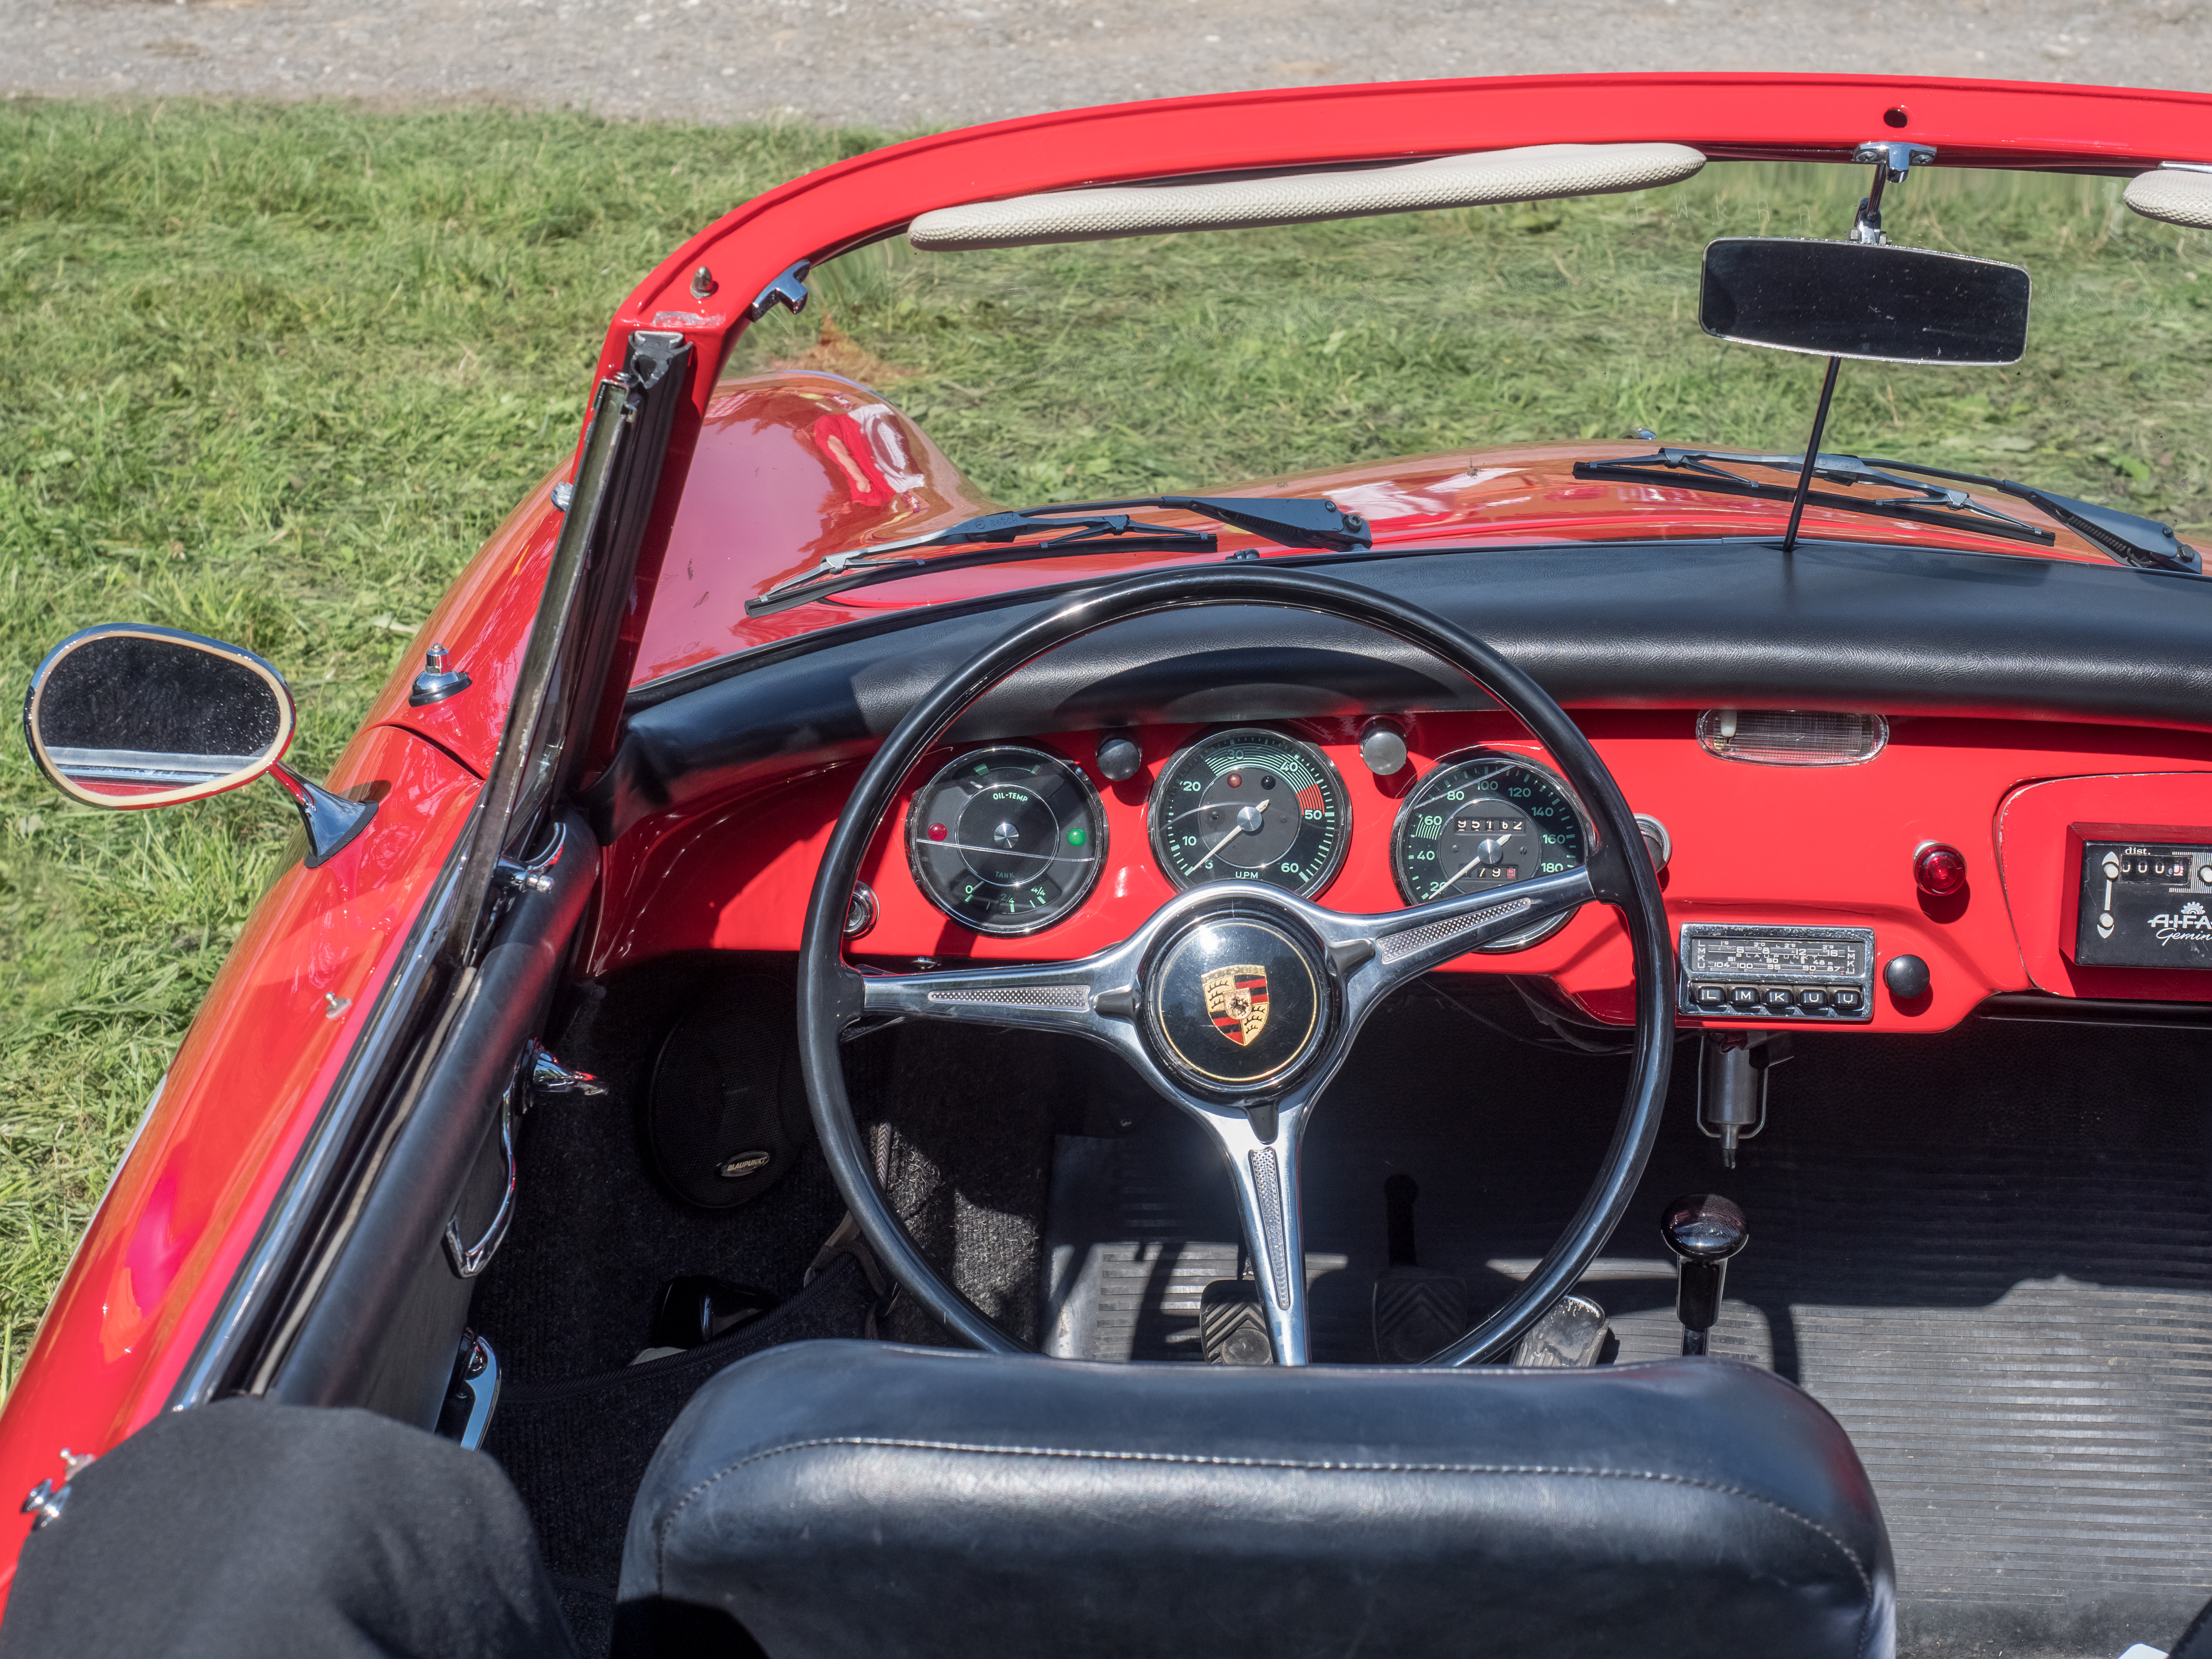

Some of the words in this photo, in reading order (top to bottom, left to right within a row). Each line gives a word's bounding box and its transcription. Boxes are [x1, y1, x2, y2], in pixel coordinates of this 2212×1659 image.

[990, 517, 1018, 526] BOSCH
[1227, 749, 1244, 760] 30
[1280, 761, 1298, 772] 40
[1184, 781, 1201, 791] 20
[1477, 781, 1498, 790] 100
[993, 792, 1028, 802] OIL-TEMP
[1447, 790, 1465, 801] 80
[1508, 787, 1531, 797] 120
[1304, 809, 1322, 820] 50
[1531, 807, 1554, 816] 140
[1424, 815, 1442, 825] 60
[1182, 836, 1197, 846] 10
[1543, 834, 1565, 844] 160
[1417, 851, 1435, 860] 40
[2125, 847, 2151, 855] dist.
[1281, 862, 1299, 873] 60
[1541, 862, 1563, 873] 180
[965, 885, 973, 893] 0
[1031, 886, 1046, 896] 4/4
[1000, 893, 1015, 904] 2/4
[1707, 990, 1716, 999] L
[1741, 991, 1751, 1000] M
[1774, 993, 1785, 1002] K
[1809, 993, 1819, 1002] U
[1843, 994, 1853, 1003] U
[727, 1157, 767, 1171] BLAUPUNKT
